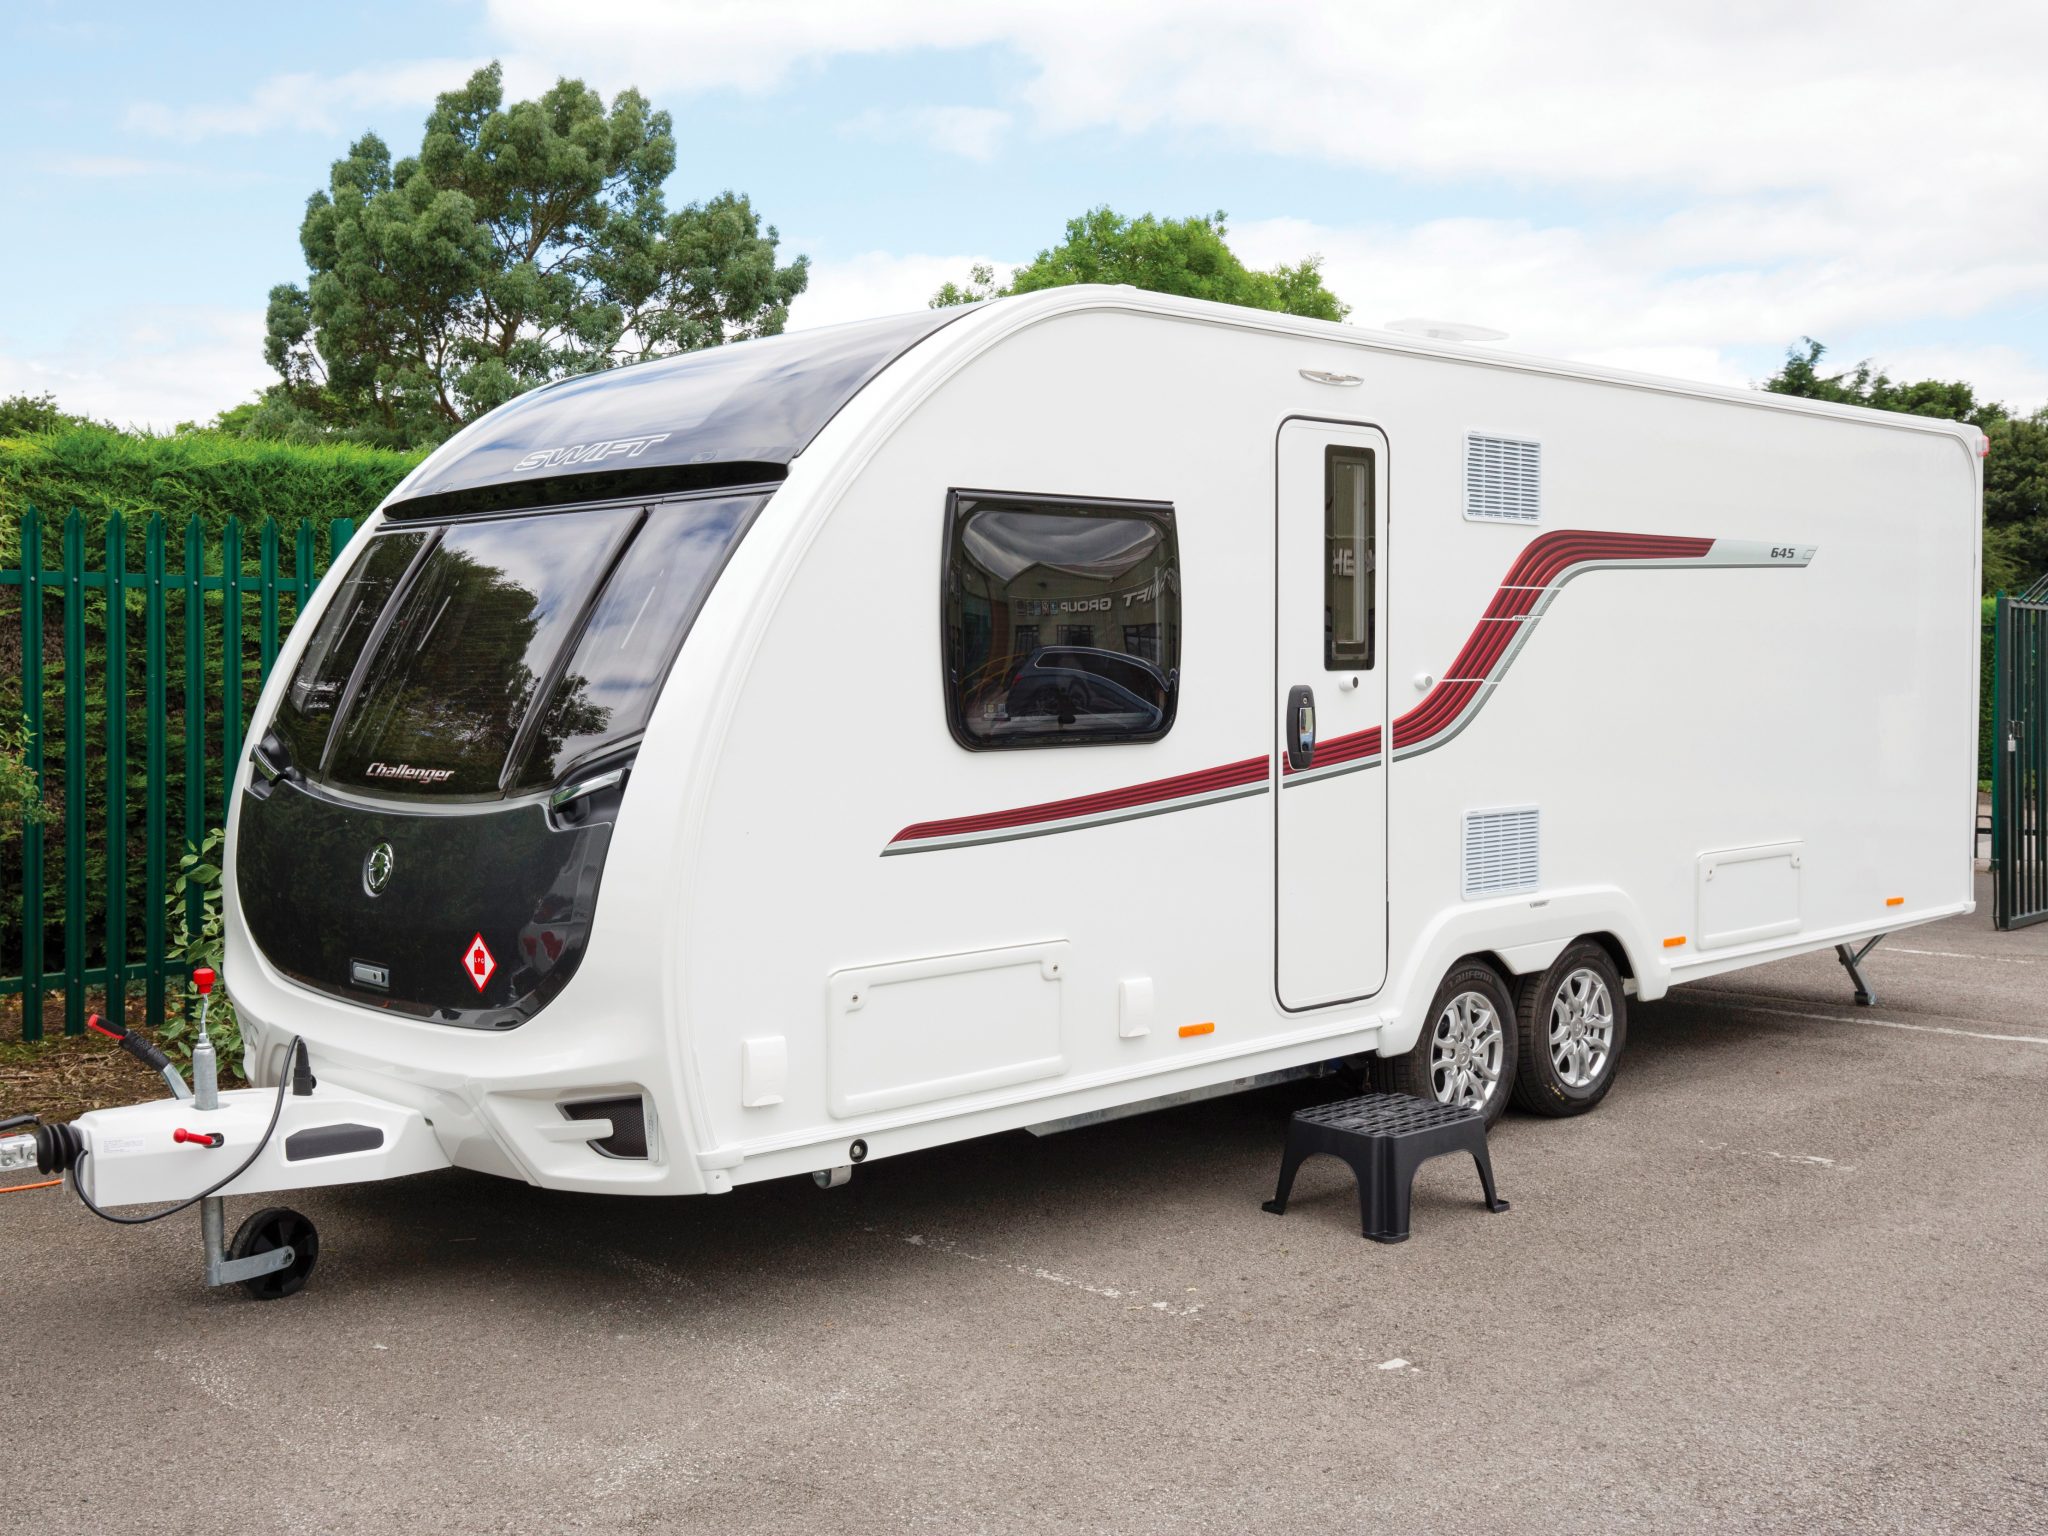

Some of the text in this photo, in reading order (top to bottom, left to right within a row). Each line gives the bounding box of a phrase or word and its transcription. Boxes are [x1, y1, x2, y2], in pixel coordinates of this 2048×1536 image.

[513, 433, 671, 471] SWIFT
[1770, 547, 1795, 558] 645
[366, 763, 455, 784] Challenger
